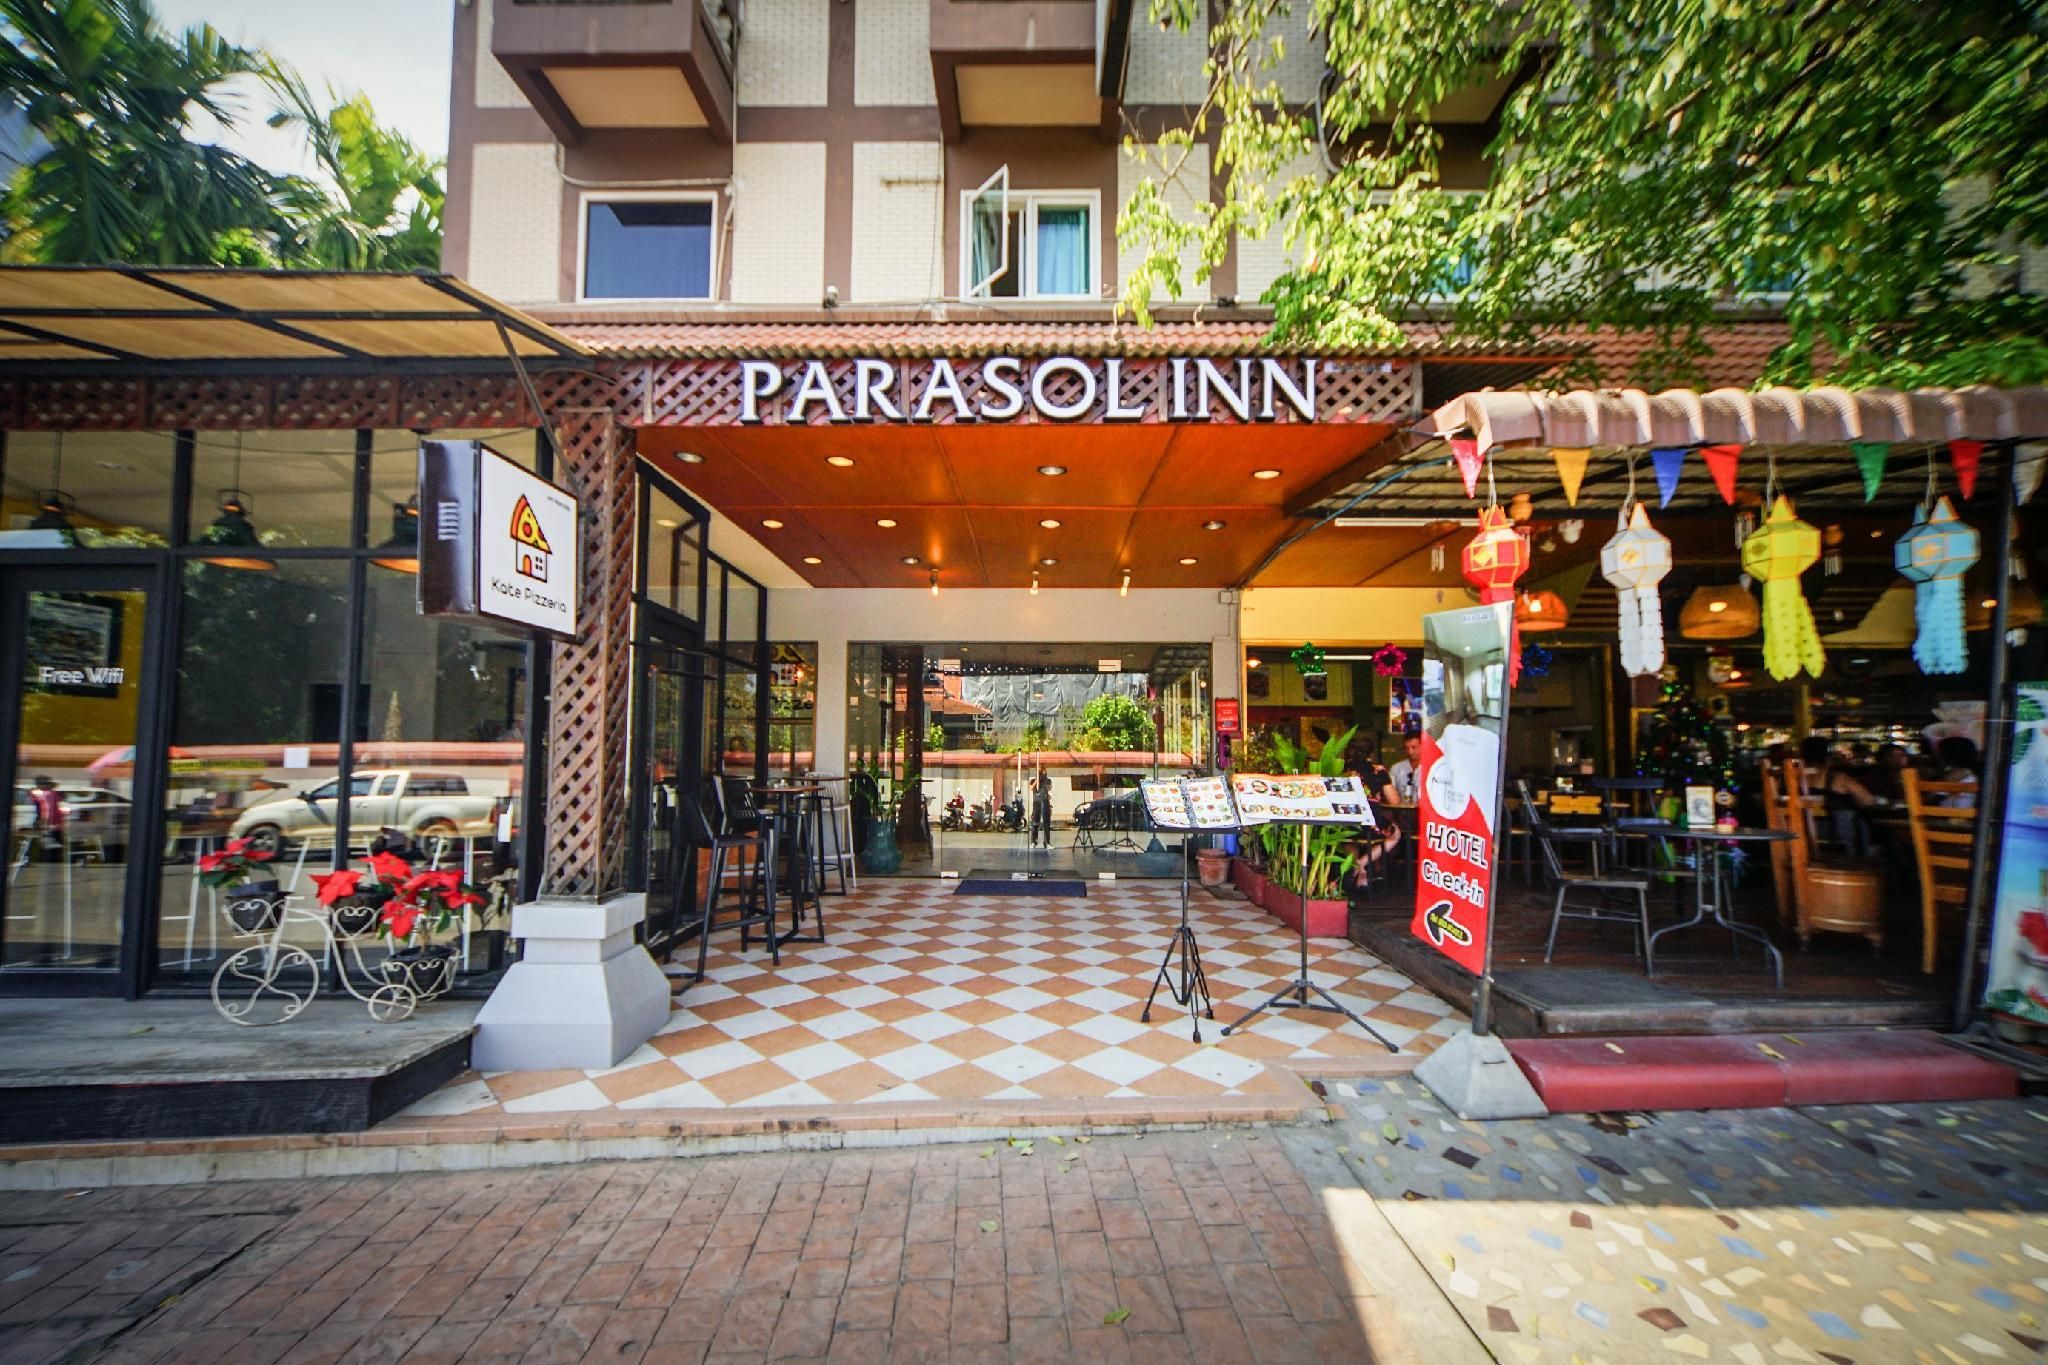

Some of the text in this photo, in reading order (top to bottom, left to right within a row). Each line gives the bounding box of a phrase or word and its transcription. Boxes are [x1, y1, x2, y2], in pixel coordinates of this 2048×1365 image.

[740, 357, 1318, 423] PARASOL INN
[491, 576, 567, 613] Kate Pizzeria
[39, 666, 124, 684] Free Wifi
[1427, 822, 1488, 869] HOTEL
[1422, 859, 1485, 908] Check-in
